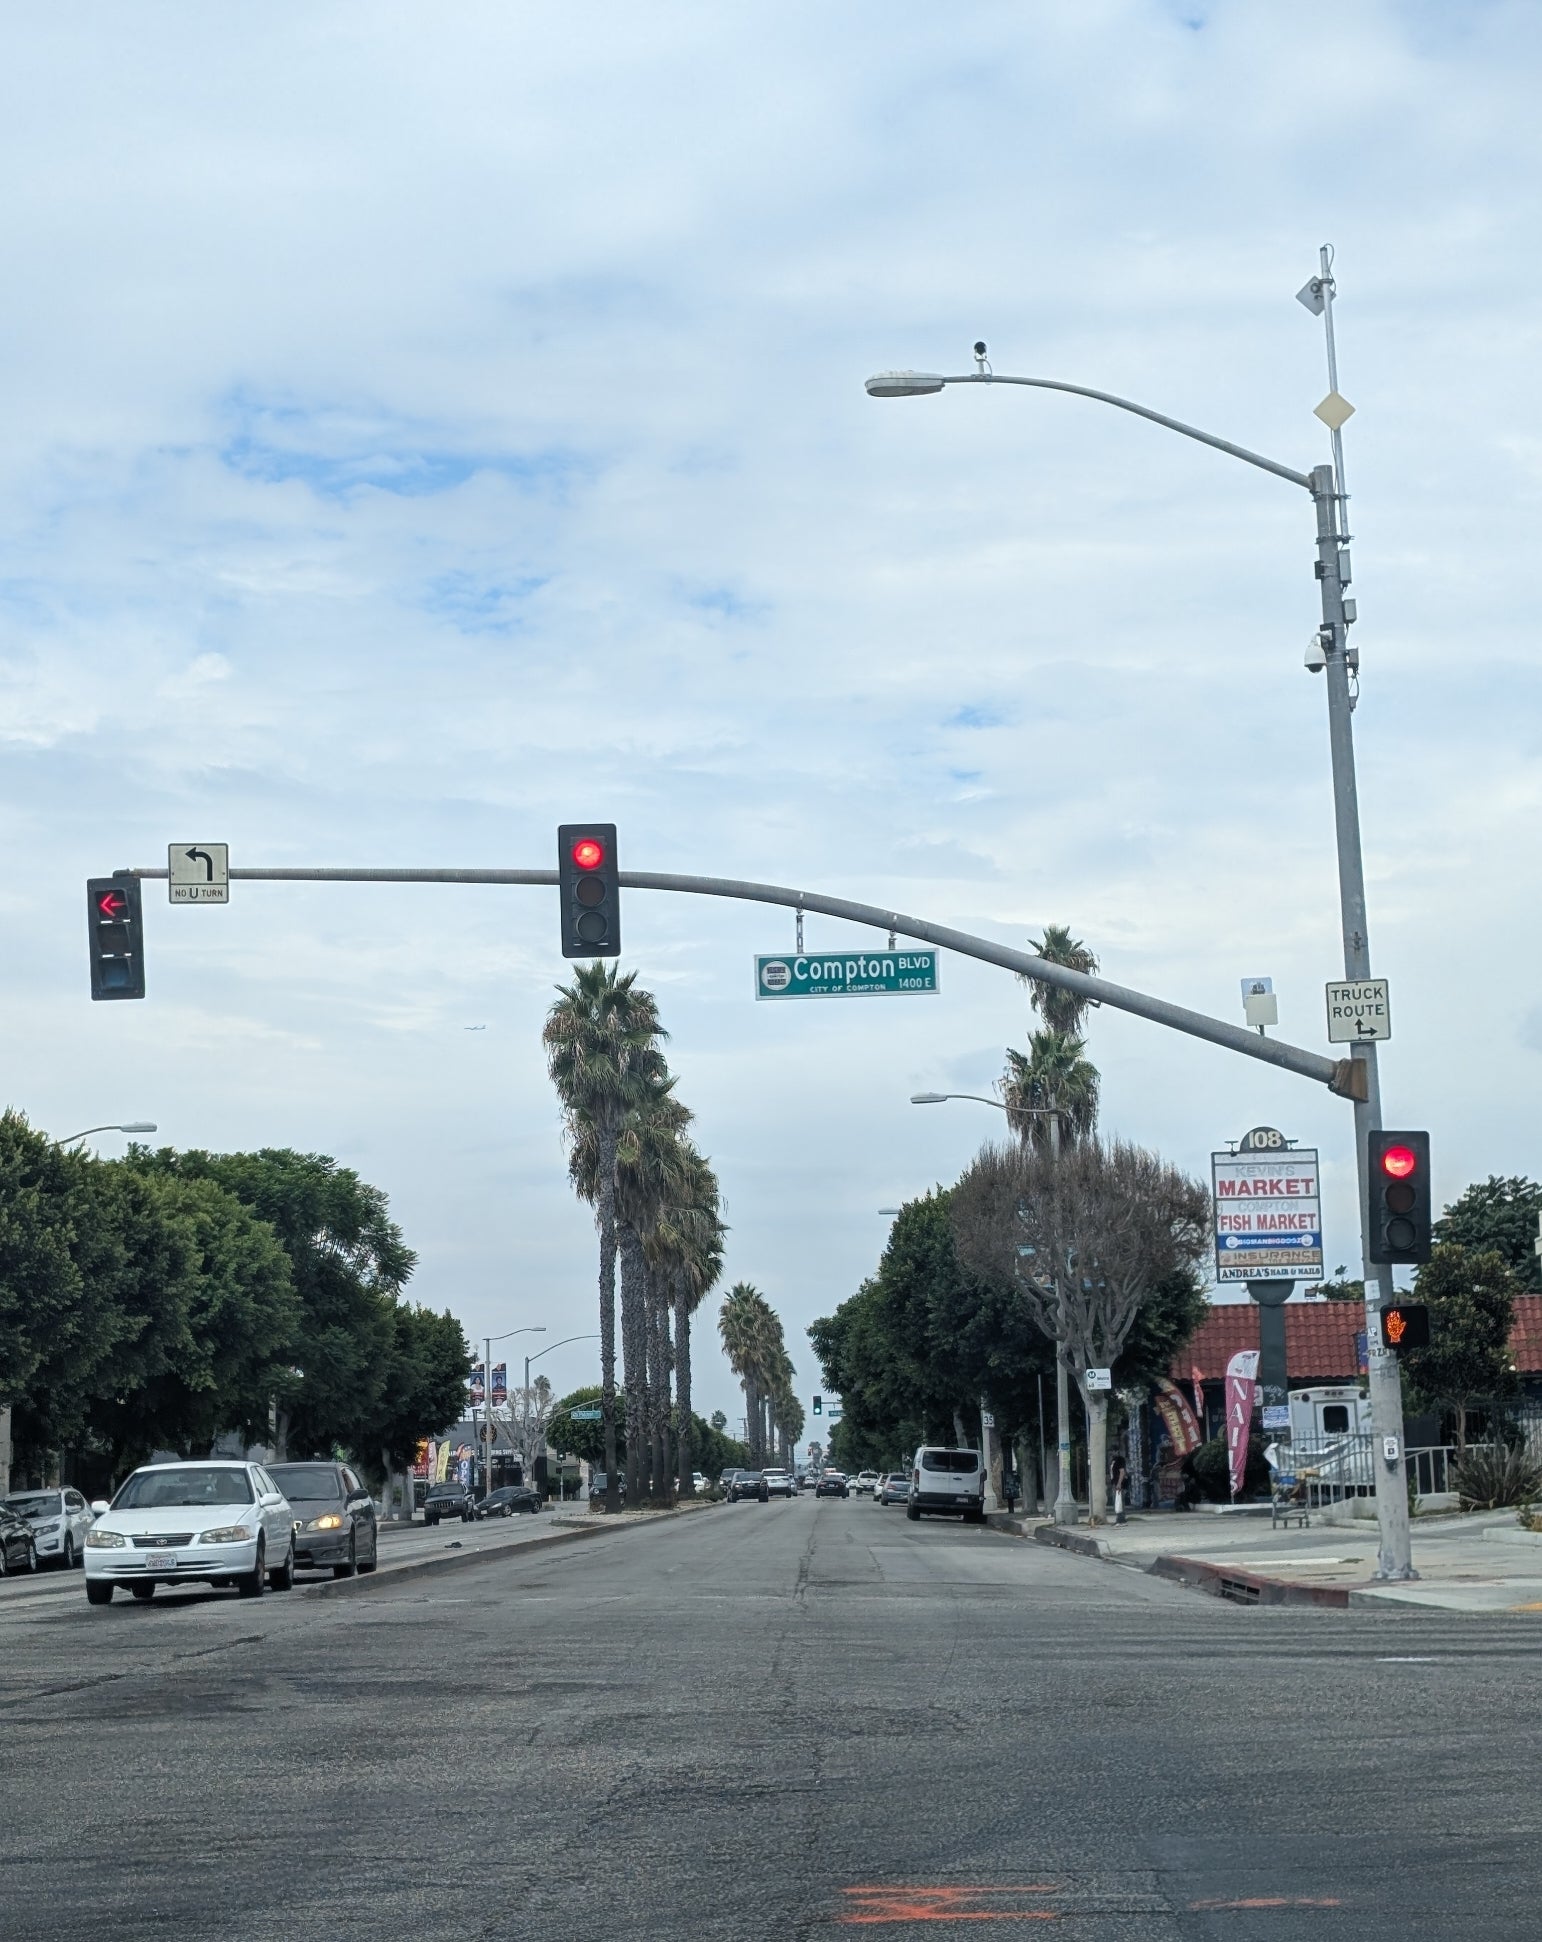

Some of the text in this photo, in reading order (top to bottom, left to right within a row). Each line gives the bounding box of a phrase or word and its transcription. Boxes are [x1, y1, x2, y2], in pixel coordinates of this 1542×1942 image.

[175, 888, 223, 898] NO U TURN
[794, 956, 895, 985] Compton
[898, 956, 931, 969] BLVD
[832, 984, 843, 992] OF
[847, 984, 886, 992] COMPTON
[898, 977, 932, 989] 1400 E
[1331, 988, 1383, 1001] TRUCK
[1333, 1004, 1384, 1018] ROUTE
[1249, 1131, 1281, 1149] 108
[1219, 1179, 1314, 1196] MARKET
[1238, 1201, 1298, 1212] COMPTON
[1220, 1213, 1316, 1231] FISH MARKET
[1234, 1250, 1320, 1259] INSURANCE
[1221, 1267, 1270, 1280] ANDREA'S
[984, 1416, 993, 1424] 35
